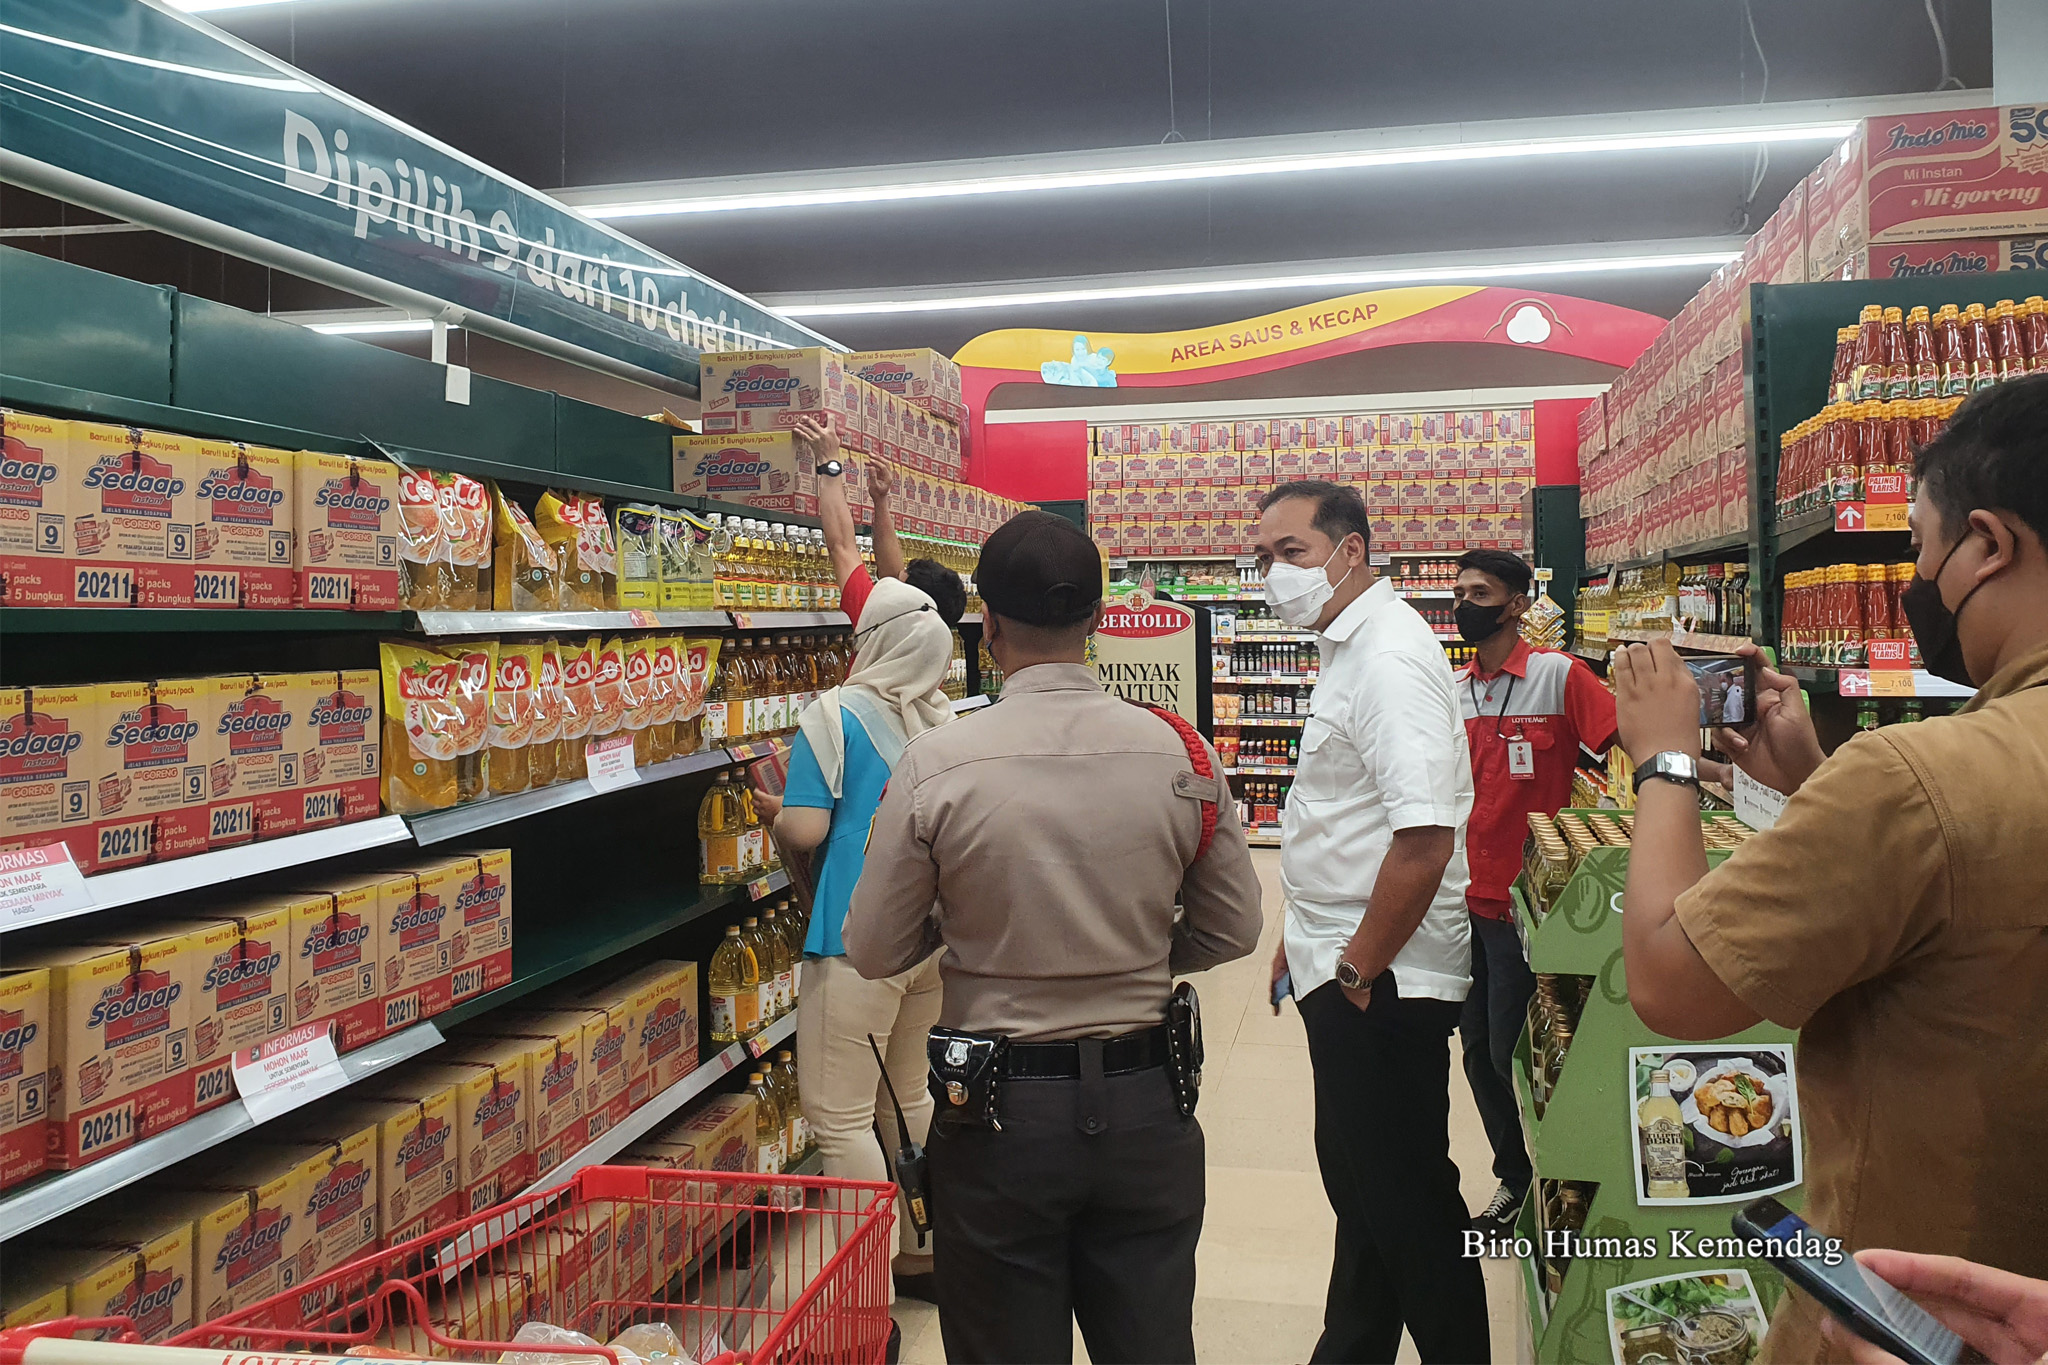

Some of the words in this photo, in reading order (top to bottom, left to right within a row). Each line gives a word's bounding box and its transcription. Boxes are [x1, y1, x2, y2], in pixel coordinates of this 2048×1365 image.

[1904, 168, 1919, 180] Mi
[1922, 167, 1963, 180] Instan
[1911, 187, 1952, 207] Mi
[1951, 186, 2042, 210] goreng
[283, 109, 480, 262] Dipilih
[490, 210, 519, 272] 9
[526, 227, 611, 313] dari
[619, 270, 659, 331] 10
[664, 290, 727, 352] chef
[1170, 338, 1225, 363] AREA
[1229, 324, 1284, 349] SAUS
[1289, 320, 1304, 336] &
[1308, 303, 1379, 332] KECAP
[722, 375, 801, 393] Sedaap
[124, 434, 132, 444] 5
[98, 455, 122, 467] Mie
[231, 450, 236, 459] 5
[702, 453, 721, 461] Mie
[209, 468, 230, 480] Mie
[693, 459, 771, 477] Sedaap
[83, 465, 186, 500] Sedaap
[325, 478, 343, 489] Mie
[1868, 475, 1895, 486] PALING
[132, 494, 164, 505] Instant
[196, 480, 284, 508] Sedaap
[314, 488, 390, 515] Sedaap
[748, 497, 791, 507] GORENG
[237, 505, 266, 514] Instant
[1885, 513, 1907, 522] 7.100
[122, 518, 161, 530] GORENG
[229, 526, 264, 538] GORENG
[45, 525, 58, 544] 9
[174, 534, 186, 552] 9
[275, 541, 285, 556] 9
[382, 544, 391, 560] 9
[13, 573, 42, 587] packs
[77, 571, 130, 599] 20211
[138, 577, 144, 588] 8
[146, 578, 172, 589] packs
[194, 574, 236, 600] 20211
[251, 581, 273, 591] packs
[311, 576, 349, 600] 20211
[15, 588, 22, 599] 5
[25, 588, 64, 602] bungkus
[148, 591, 155, 602] 5
[157, 591, 191, 605] bungkus
[252, 595, 258, 603] 5
[259, 595, 290, 606] bungkus
[1098, 613, 1182, 629] BERTOLLI
[1871, 642, 1897, 652] PALING
[1098, 663, 1181, 682] MINYAK
[228, 702, 245, 712] Mie
[316, 697, 332, 706] Mie
[120, 711, 142, 722] Mie
[216, 710, 293, 735] Sedaap
[307, 705, 373, 728] Sedaap
[0, 731, 83, 756] edaap
[151, 744, 180, 754] Instant
[22, 756, 59, 768] Instant
[366, 753, 373, 768] 9
[142, 768, 178, 781] GORENG
[284, 763, 293, 779] 9
[12, 783, 55, 798] GORENG
[190, 776, 200, 794] 9
[69, 793, 82, 813] 9
[305, 793, 338, 819] 20211
[262, 806, 281, 818] packs
[212, 806, 251, 836] 20211
[263, 820, 269, 830] 5
[270, 817, 296, 830] bungkus
[164, 825, 187, 838] packs
[101, 825, 149, 858] 20211
[165, 840, 171, 850] 5
[173, 834, 205, 850] bungkus
[15, 872, 43, 886] MAAF
[9, 882, 47, 897] SEMENTARA
[33, 888, 65, 903] MINYAK
[454, 883, 506, 910] Sedaap
[12, 905, 35, 916] HABIS
[389, 903, 447, 935] Sedaap
[300, 923, 370, 958] Sedaap
[203, 951, 282, 992] Sedaap
[362, 977, 371, 990] 9
[452, 970, 481, 996] 20211
[102, 984, 124, 999] Mie
[86, 981, 182, 1029] Sedaap
[386, 995, 418, 1026] 20211
[272, 1004, 282, 1024] 9
[640, 1008, 687, 1048] Sedaap
[263, 1025, 316, 1057] INFORMASI
[172, 1040, 182, 1061] 9
[263, 1056, 290, 1073] MOHON
[289, 1047, 309, 1062] MAAF
[268, 1070, 285, 1080] UNTUK
[284, 1059, 310, 1074] SEMENTARA
[473, 1088, 520, 1127] Sedaap
[82, 1113, 132, 1150] 20211
[396, 1125, 451, 1168] Sedaap
[304, 1167, 371, 1217] Sedaap
[472, 1174, 499, 1211] 20211
